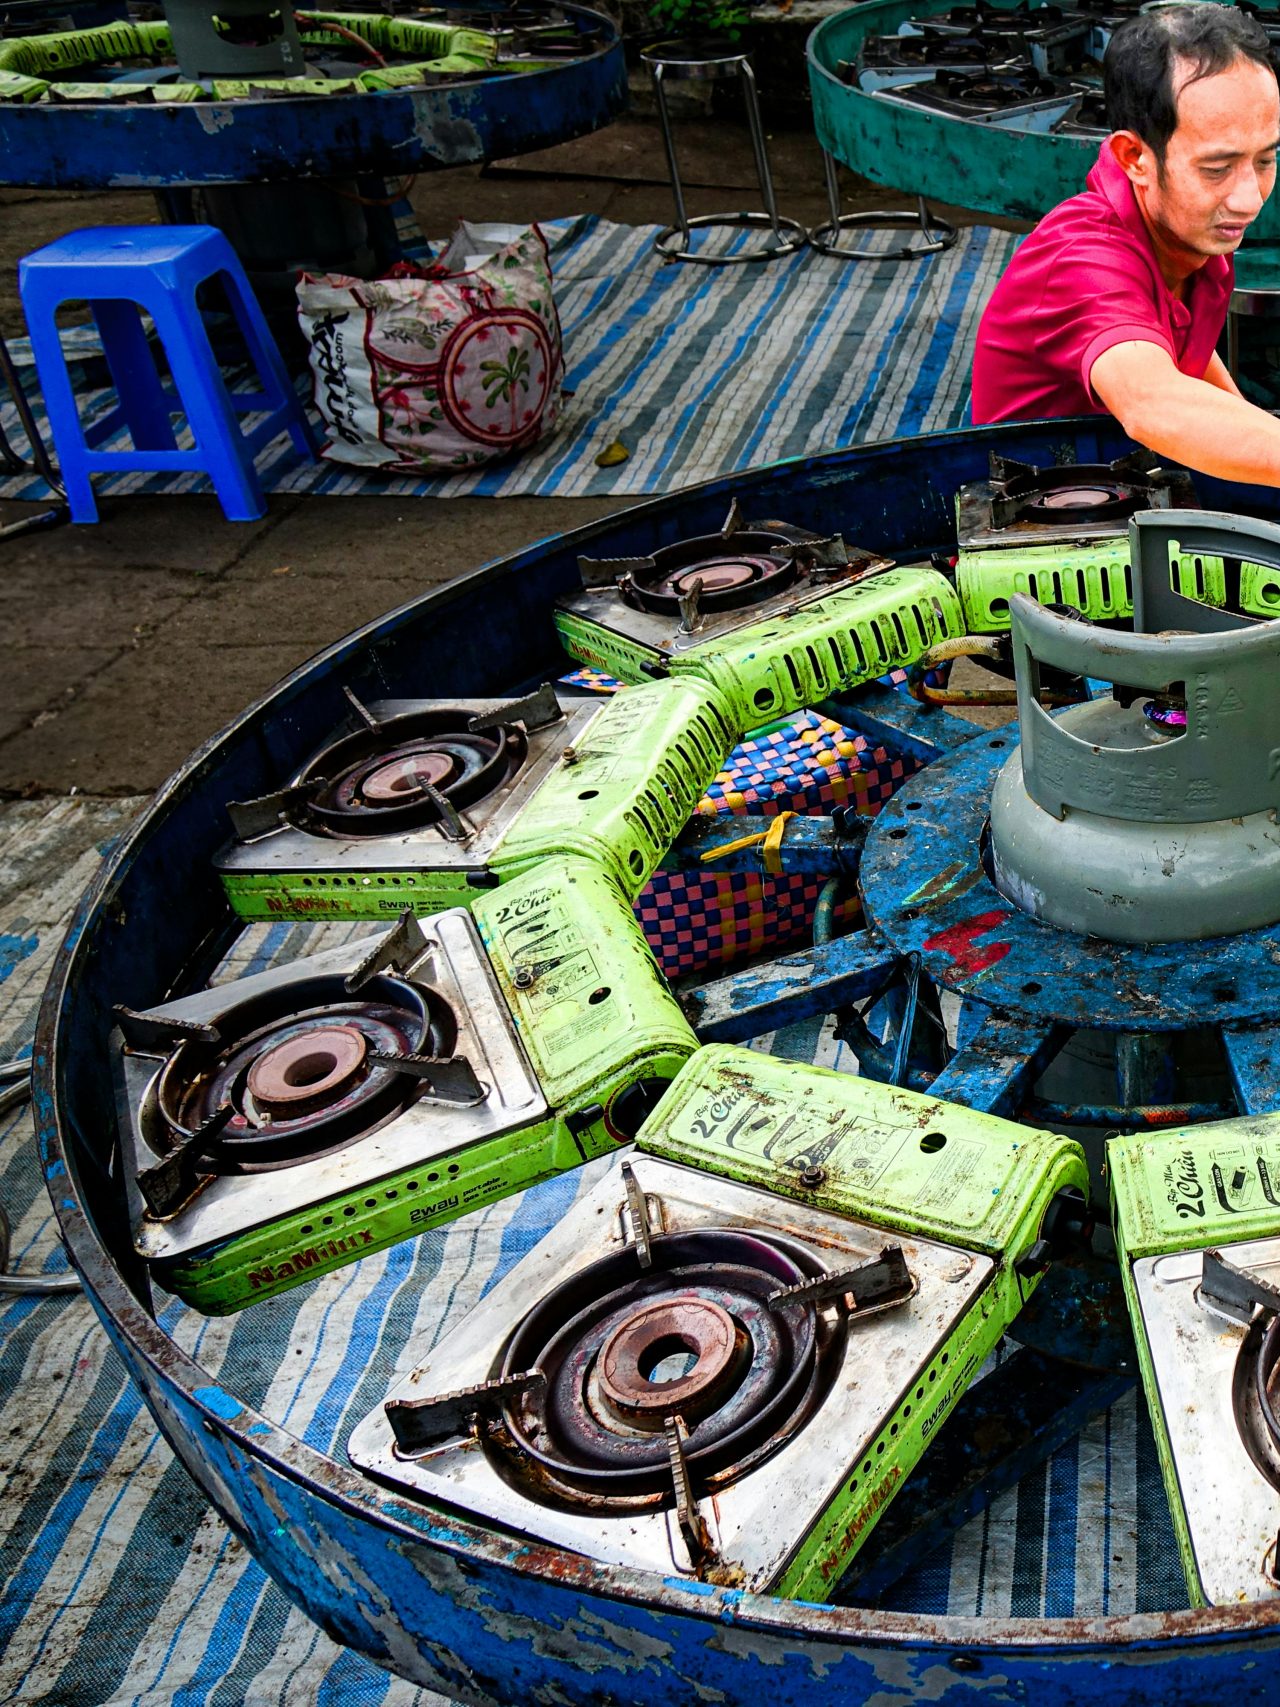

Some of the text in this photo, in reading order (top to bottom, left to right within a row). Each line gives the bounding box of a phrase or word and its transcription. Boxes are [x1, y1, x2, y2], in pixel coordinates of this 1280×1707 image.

[495, 907, 514, 925] 2
[690, 1119, 719, 1138] 2
[462, 1175, 501, 1197] portable
[463, 1179, 508, 1203] gas stove
[409, 1195, 459, 1224] 2way
[1176, 1201, 1206, 1219] 2
[246, 1226, 375, 1290] NaMilux
